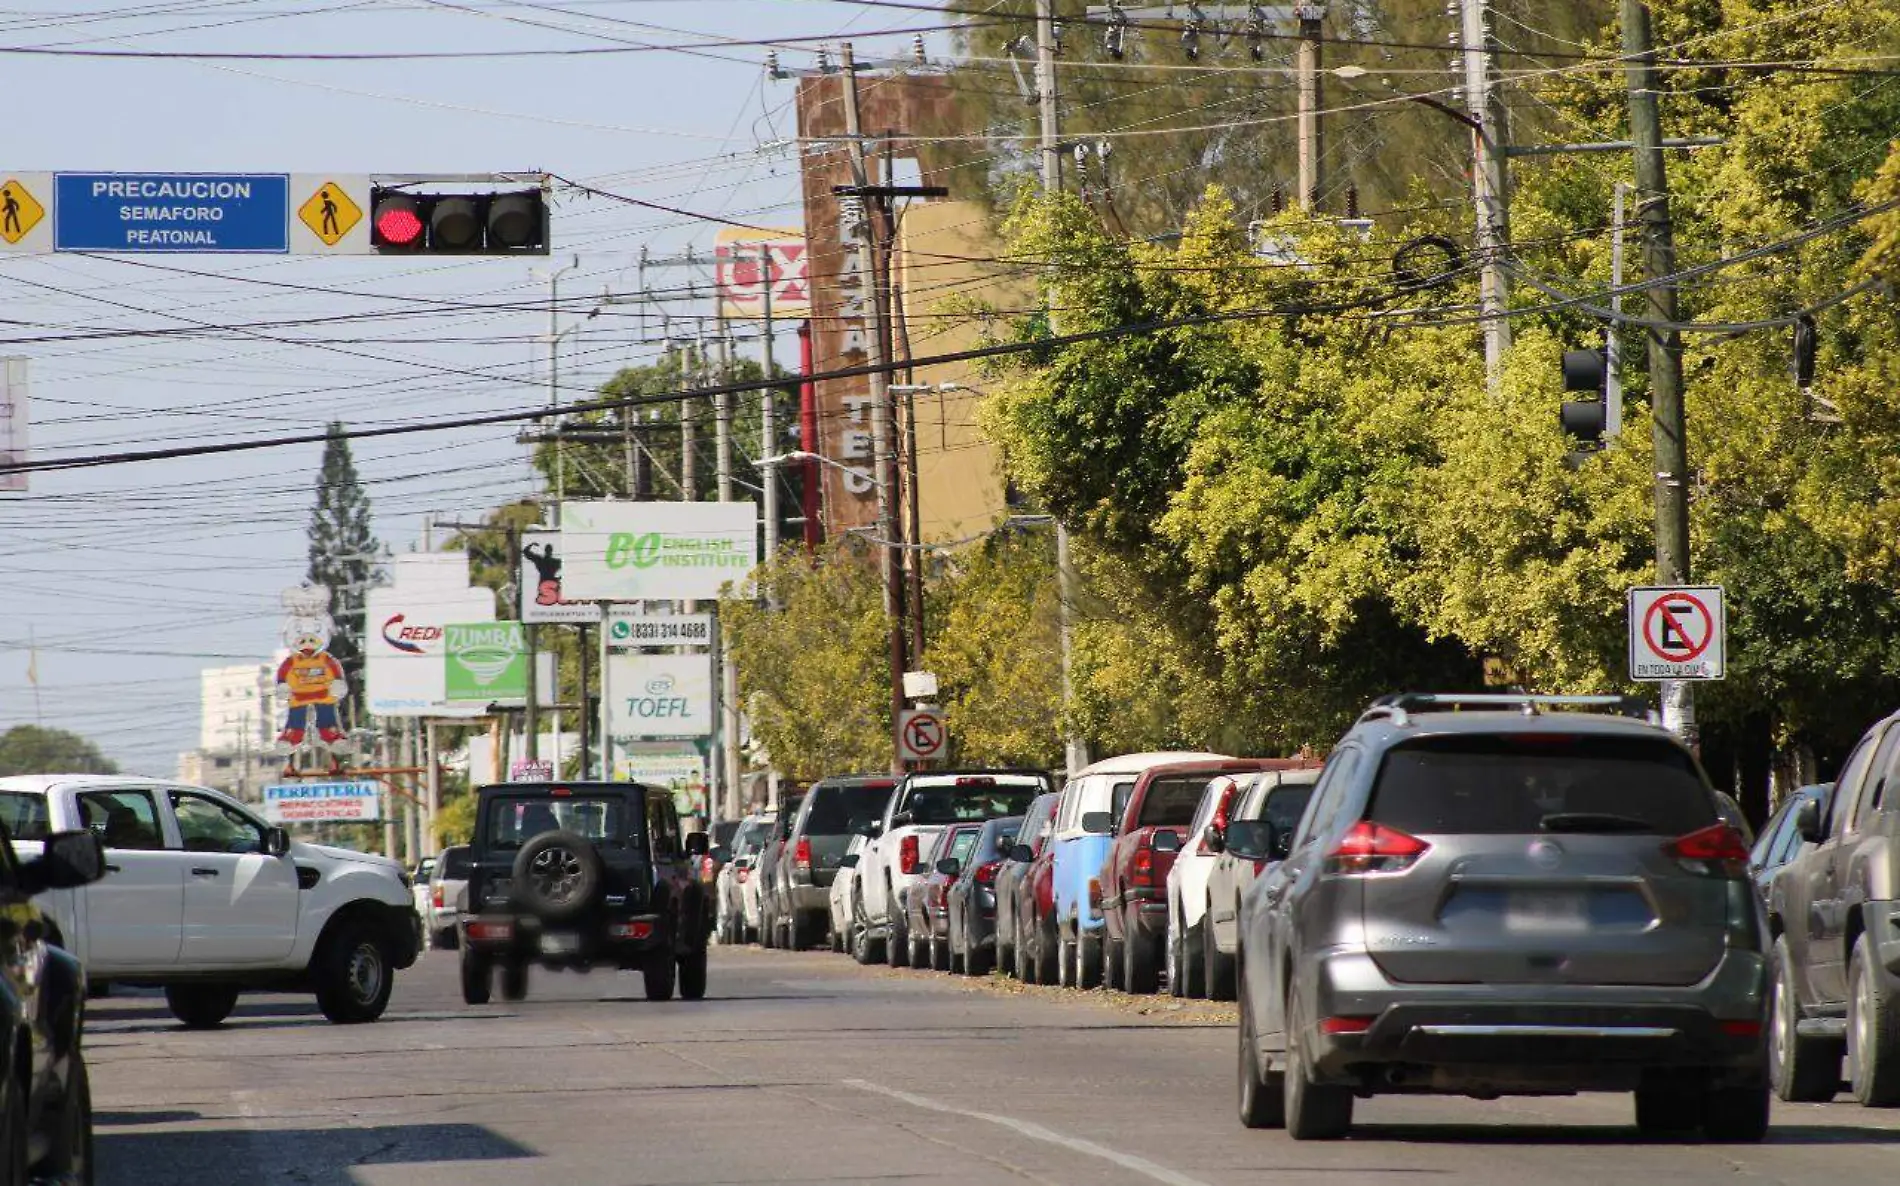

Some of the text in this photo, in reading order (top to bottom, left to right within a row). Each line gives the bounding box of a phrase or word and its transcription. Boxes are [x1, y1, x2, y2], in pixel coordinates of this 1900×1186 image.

[92, 181, 251, 198] PRECAUCION
[119, 206, 224, 221] SEMAFORO
[126, 229, 217, 244] PEATONAL
[662, 538, 733, 550] ENGLISH
[662, 554, 749, 567] INSTITUTE
[662, 623, 678, 638] 314
[449, 626, 523, 651] ZUMBA
[626, 698, 691, 718] TOEFL
[267, 784, 373, 799] FERRETERIA
